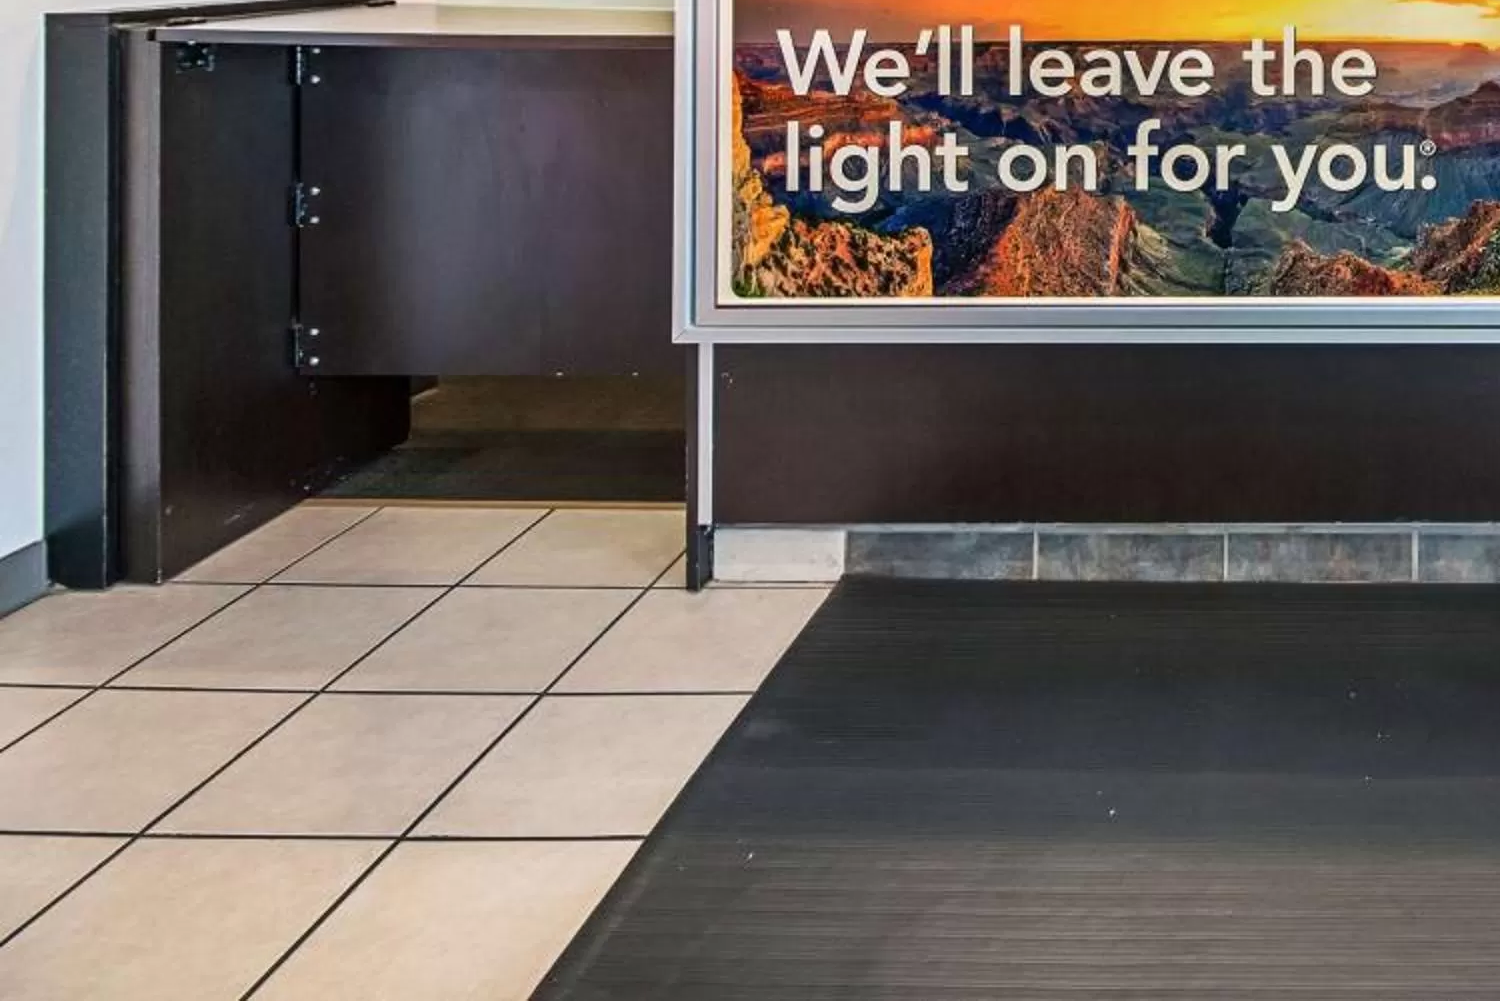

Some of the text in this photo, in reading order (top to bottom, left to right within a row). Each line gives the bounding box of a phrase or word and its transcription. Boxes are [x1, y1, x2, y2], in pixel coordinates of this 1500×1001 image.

[776, 25, 1377, 97] We'll leave the
[785, 120, 969, 213] light
[998, 140, 1097, 192] on
[1127, 119, 1246, 192] for
